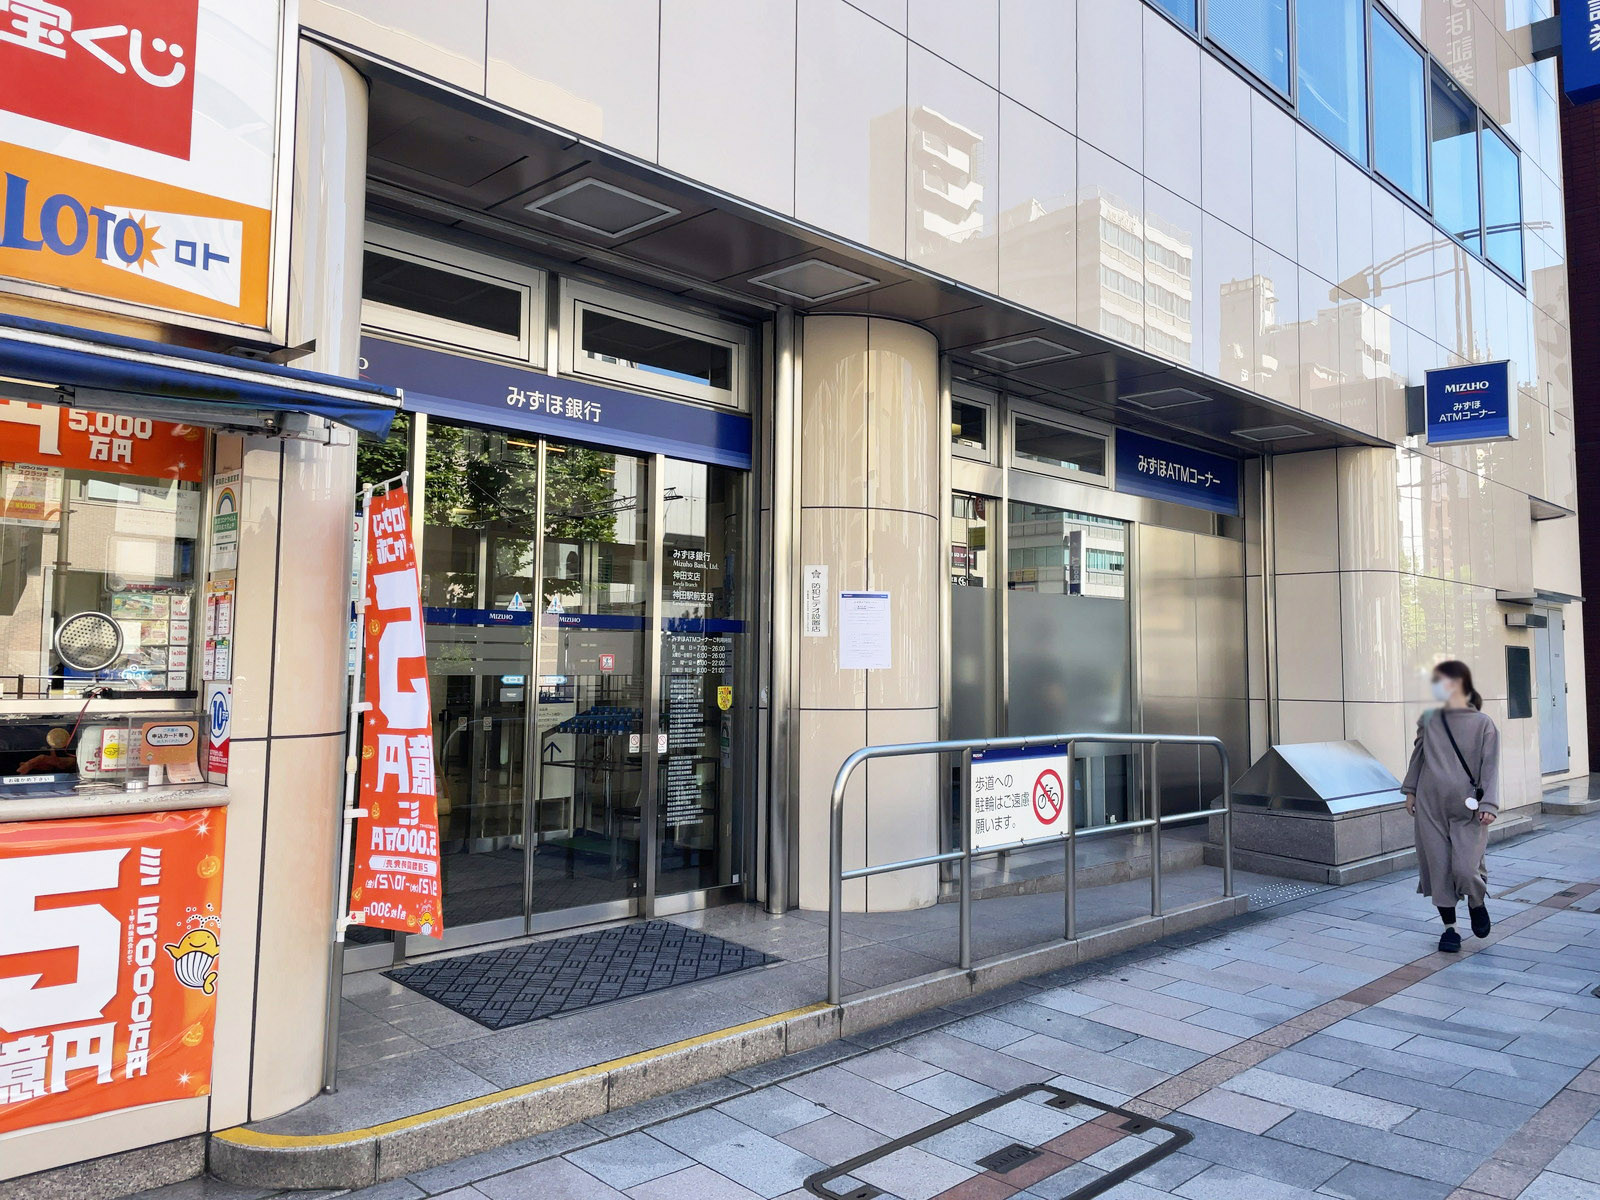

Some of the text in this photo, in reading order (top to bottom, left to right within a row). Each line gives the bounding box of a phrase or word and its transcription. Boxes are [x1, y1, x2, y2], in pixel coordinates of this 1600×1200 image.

[0, 0, 186, 88] 宝くじ
[1, 171, 145, 264] LOTO
[174, 239, 230, 271] ロト
[1445, 381, 1489, 393] MIZUHO
[506, 386, 602, 423] みずほ銀行
[1453, 400, 1481, 411] みずほ
[1439, 409, 1496, 422] ATMコーナー
[88, 434, 134, 464] 万円
[1137, 454, 1221, 488] みずほATMコーナー
[672, 549, 711, 562] みずほ銀行
[673, 560, 693, 568] Mizuho
[673, 570, 701, 581] 神田支店
[489, 612, 514, 621] MIZUHO
[558, 616, 582, 624] MIZUHO
[975, 774, 1014, 793] 歩道への
[975, 791, 1030, 814] 駐輪はご遠慮
[975, 814, 1016, 835] 願います。
[0, 848, 132, 1033] 5
